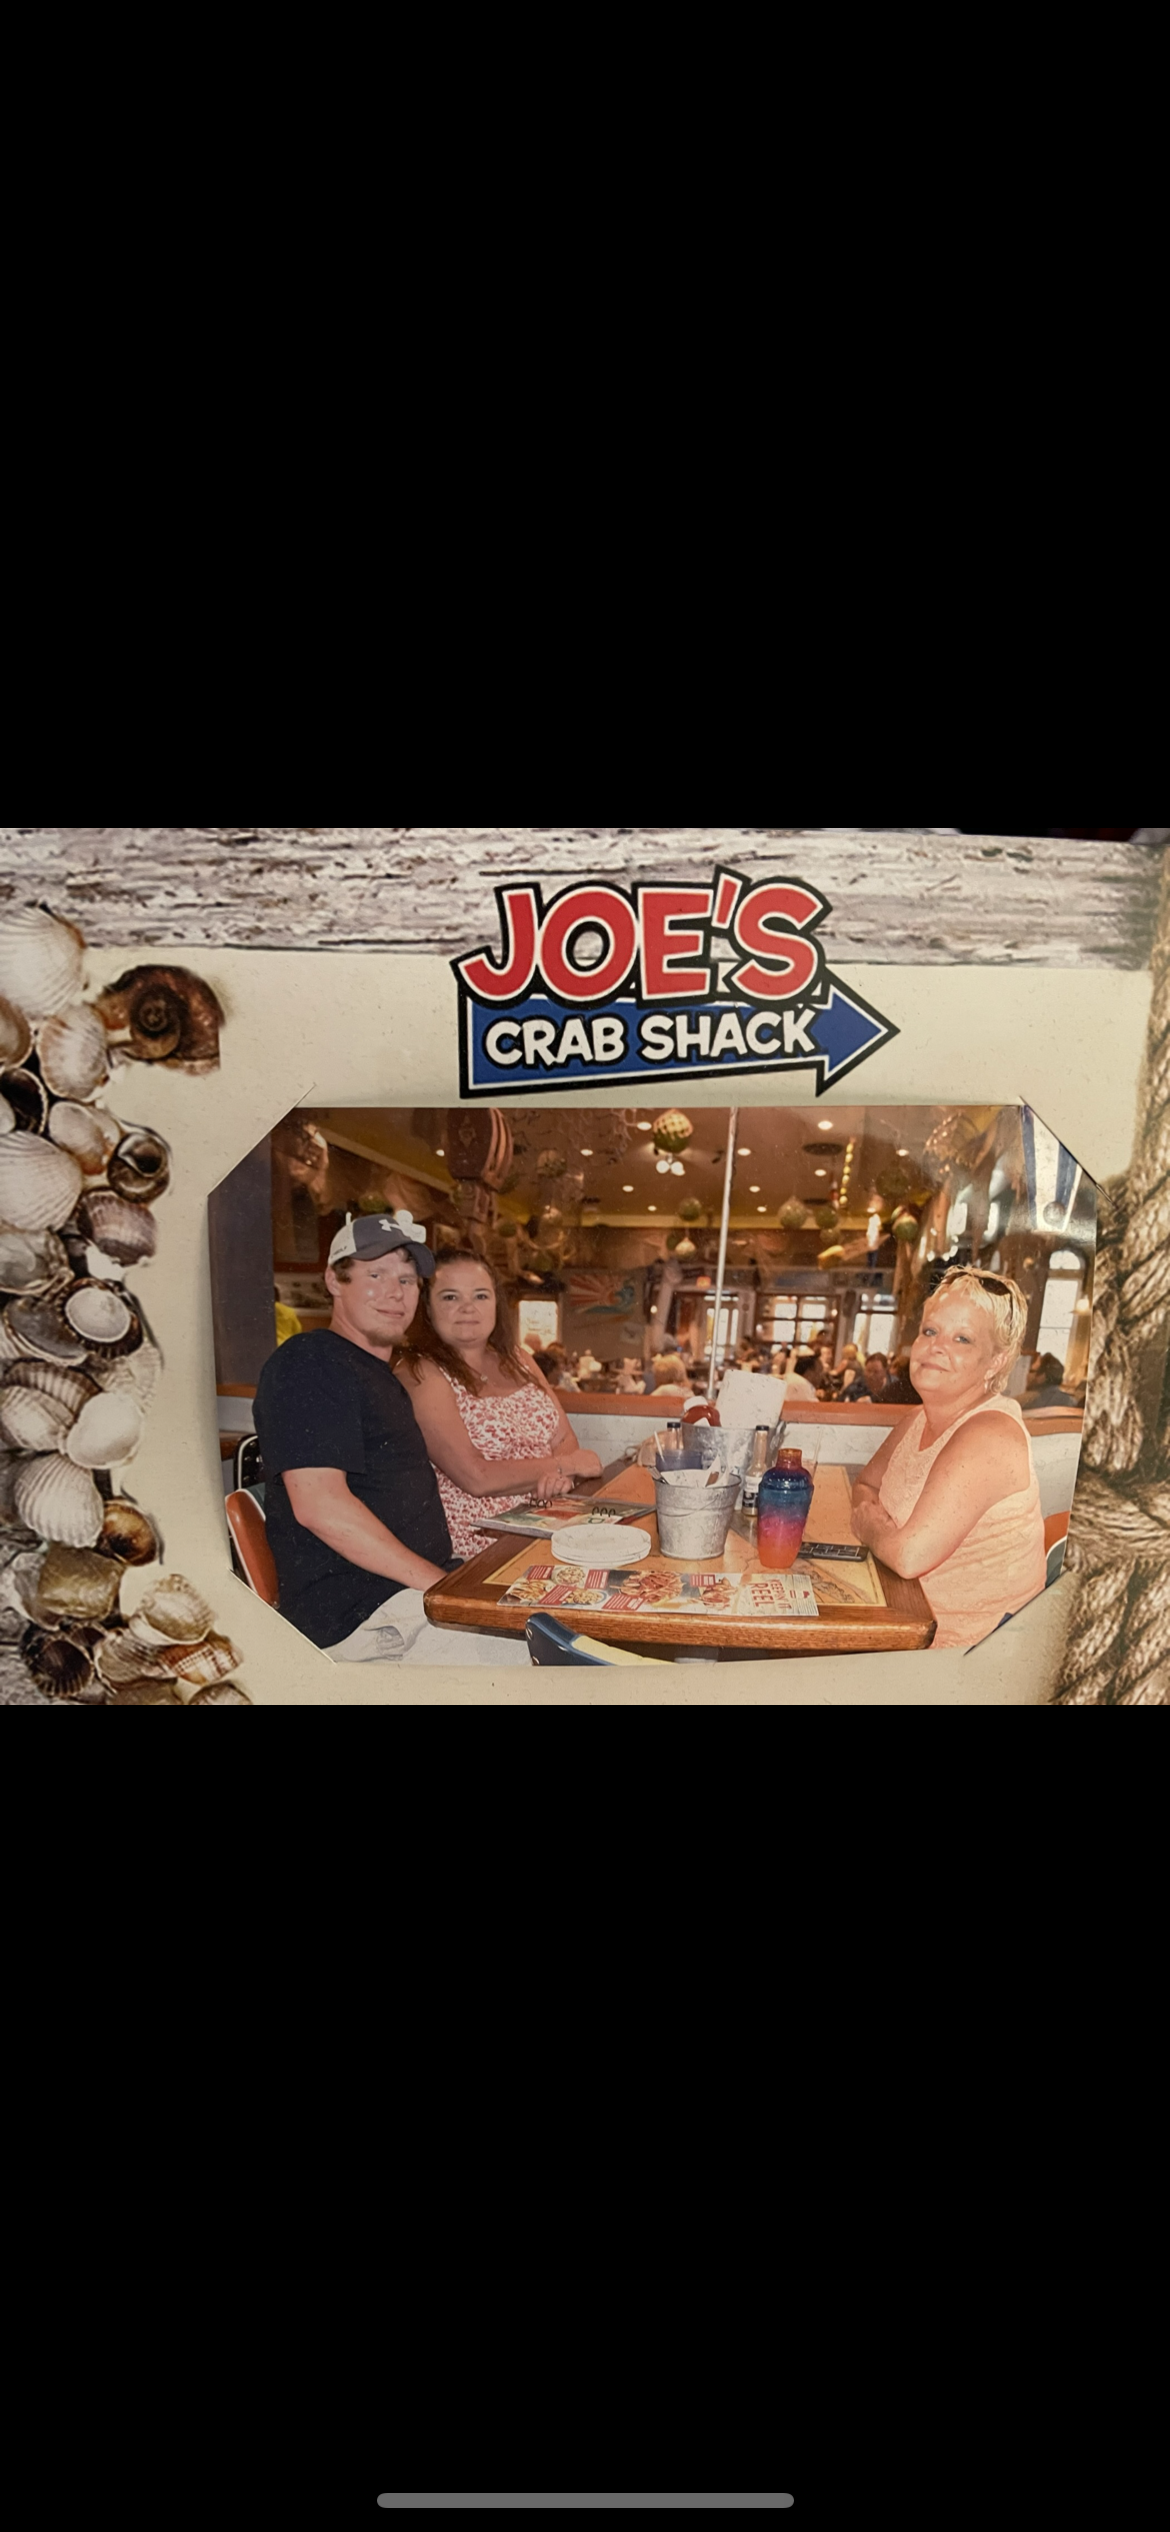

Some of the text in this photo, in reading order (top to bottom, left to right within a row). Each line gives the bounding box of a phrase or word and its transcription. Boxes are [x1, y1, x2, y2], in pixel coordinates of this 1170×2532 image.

[459, 873, 823, 1000] JOE'S
[486, 1008, 815, 1066] CRAB SHACK
[748, 1582, 775, 1607] REEL
